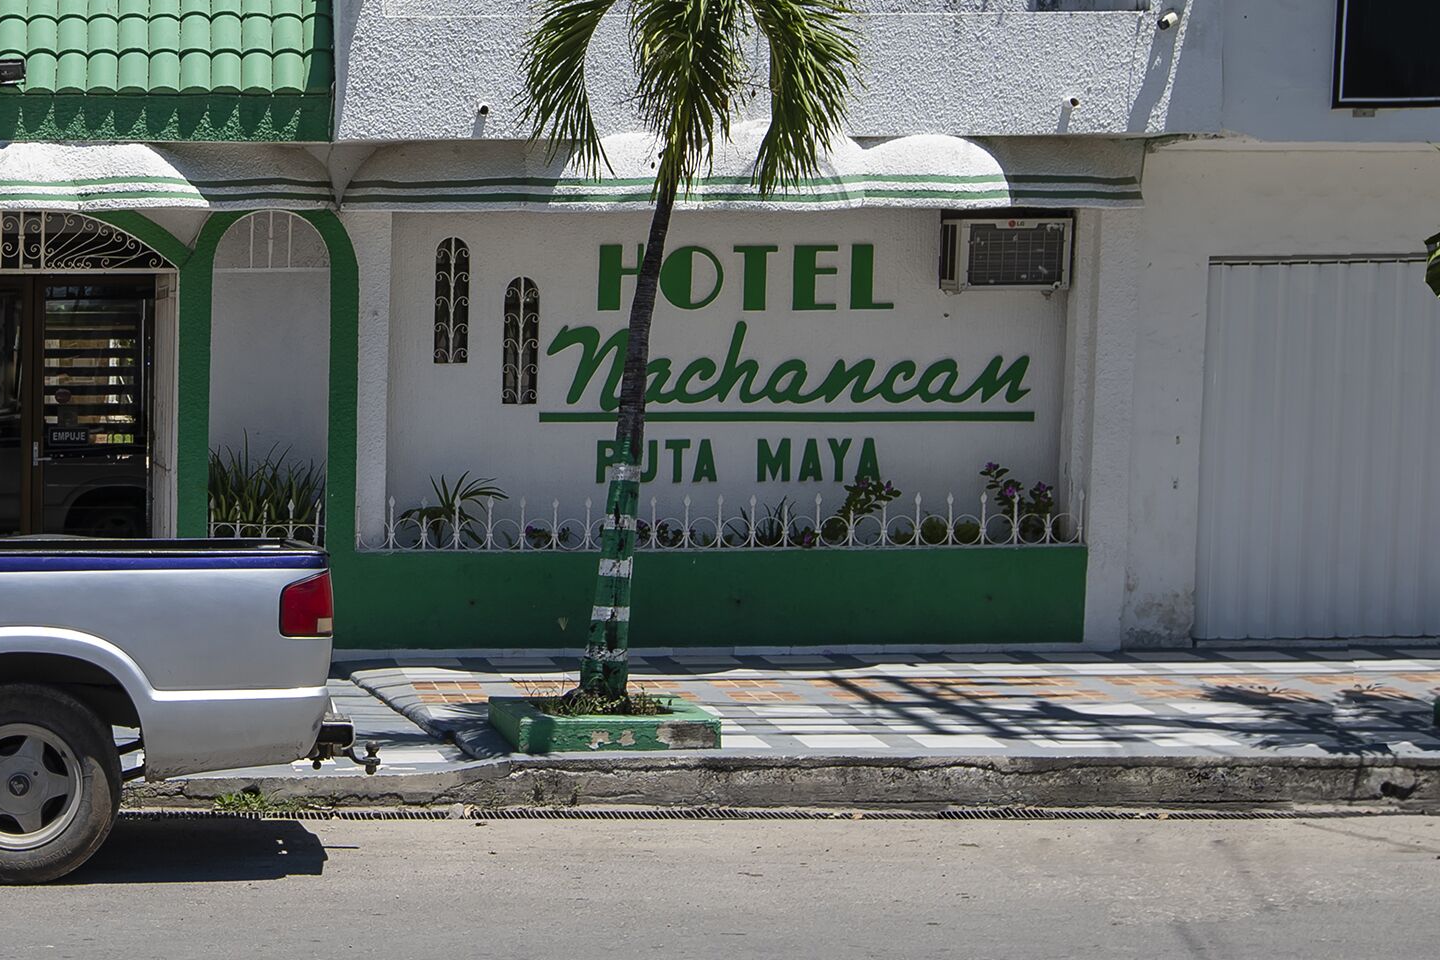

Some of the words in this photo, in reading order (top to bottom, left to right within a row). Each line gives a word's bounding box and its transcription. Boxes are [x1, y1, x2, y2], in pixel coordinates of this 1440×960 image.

[597, 244, 895, 311] HOTEL
[546, 321, 1031, 411] Nachancan
[52, 431, 86, 441] EMPUJE
[757, 438, 881, 482] MAYA
